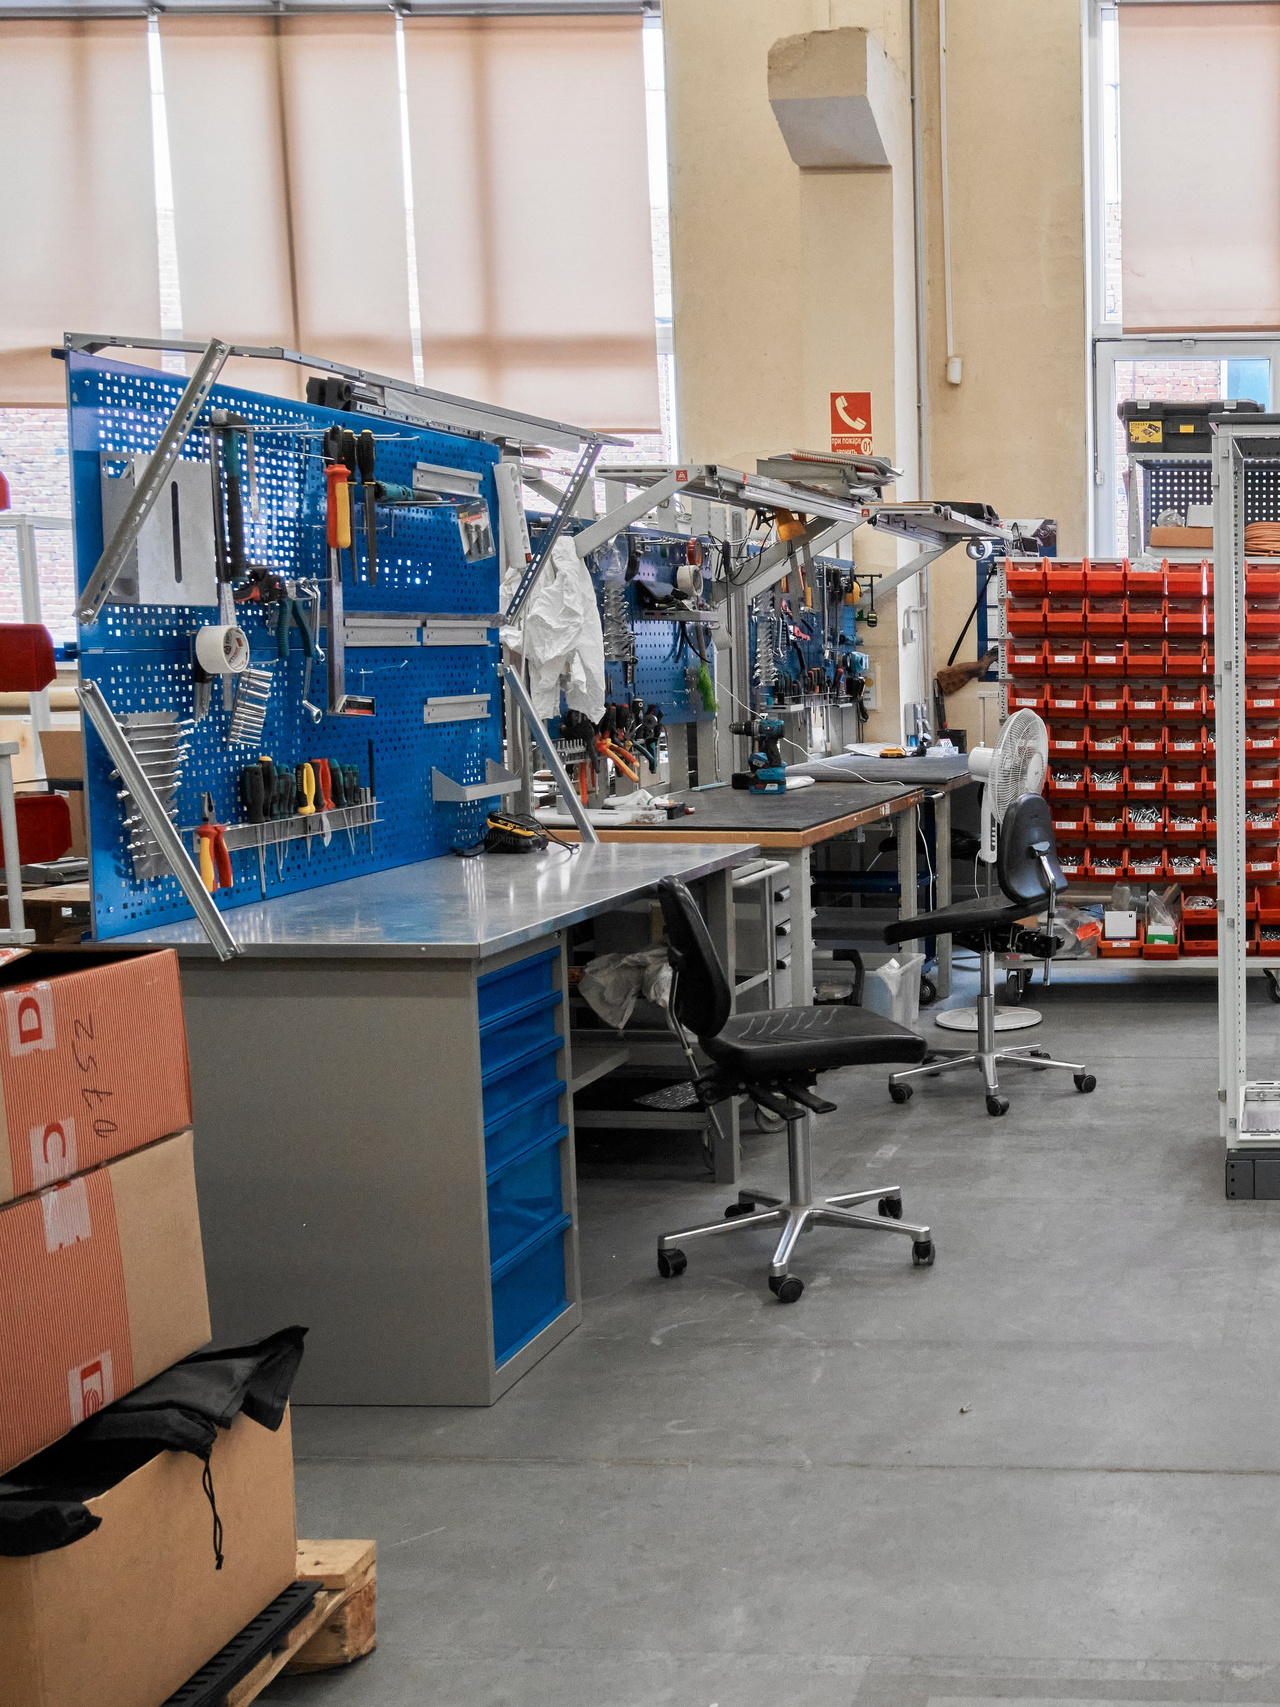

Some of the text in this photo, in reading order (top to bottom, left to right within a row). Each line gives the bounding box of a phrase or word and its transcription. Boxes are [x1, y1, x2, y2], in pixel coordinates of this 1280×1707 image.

[831, 438, 861, 446] при пожаре
[864, 440, 871, 452] 01
